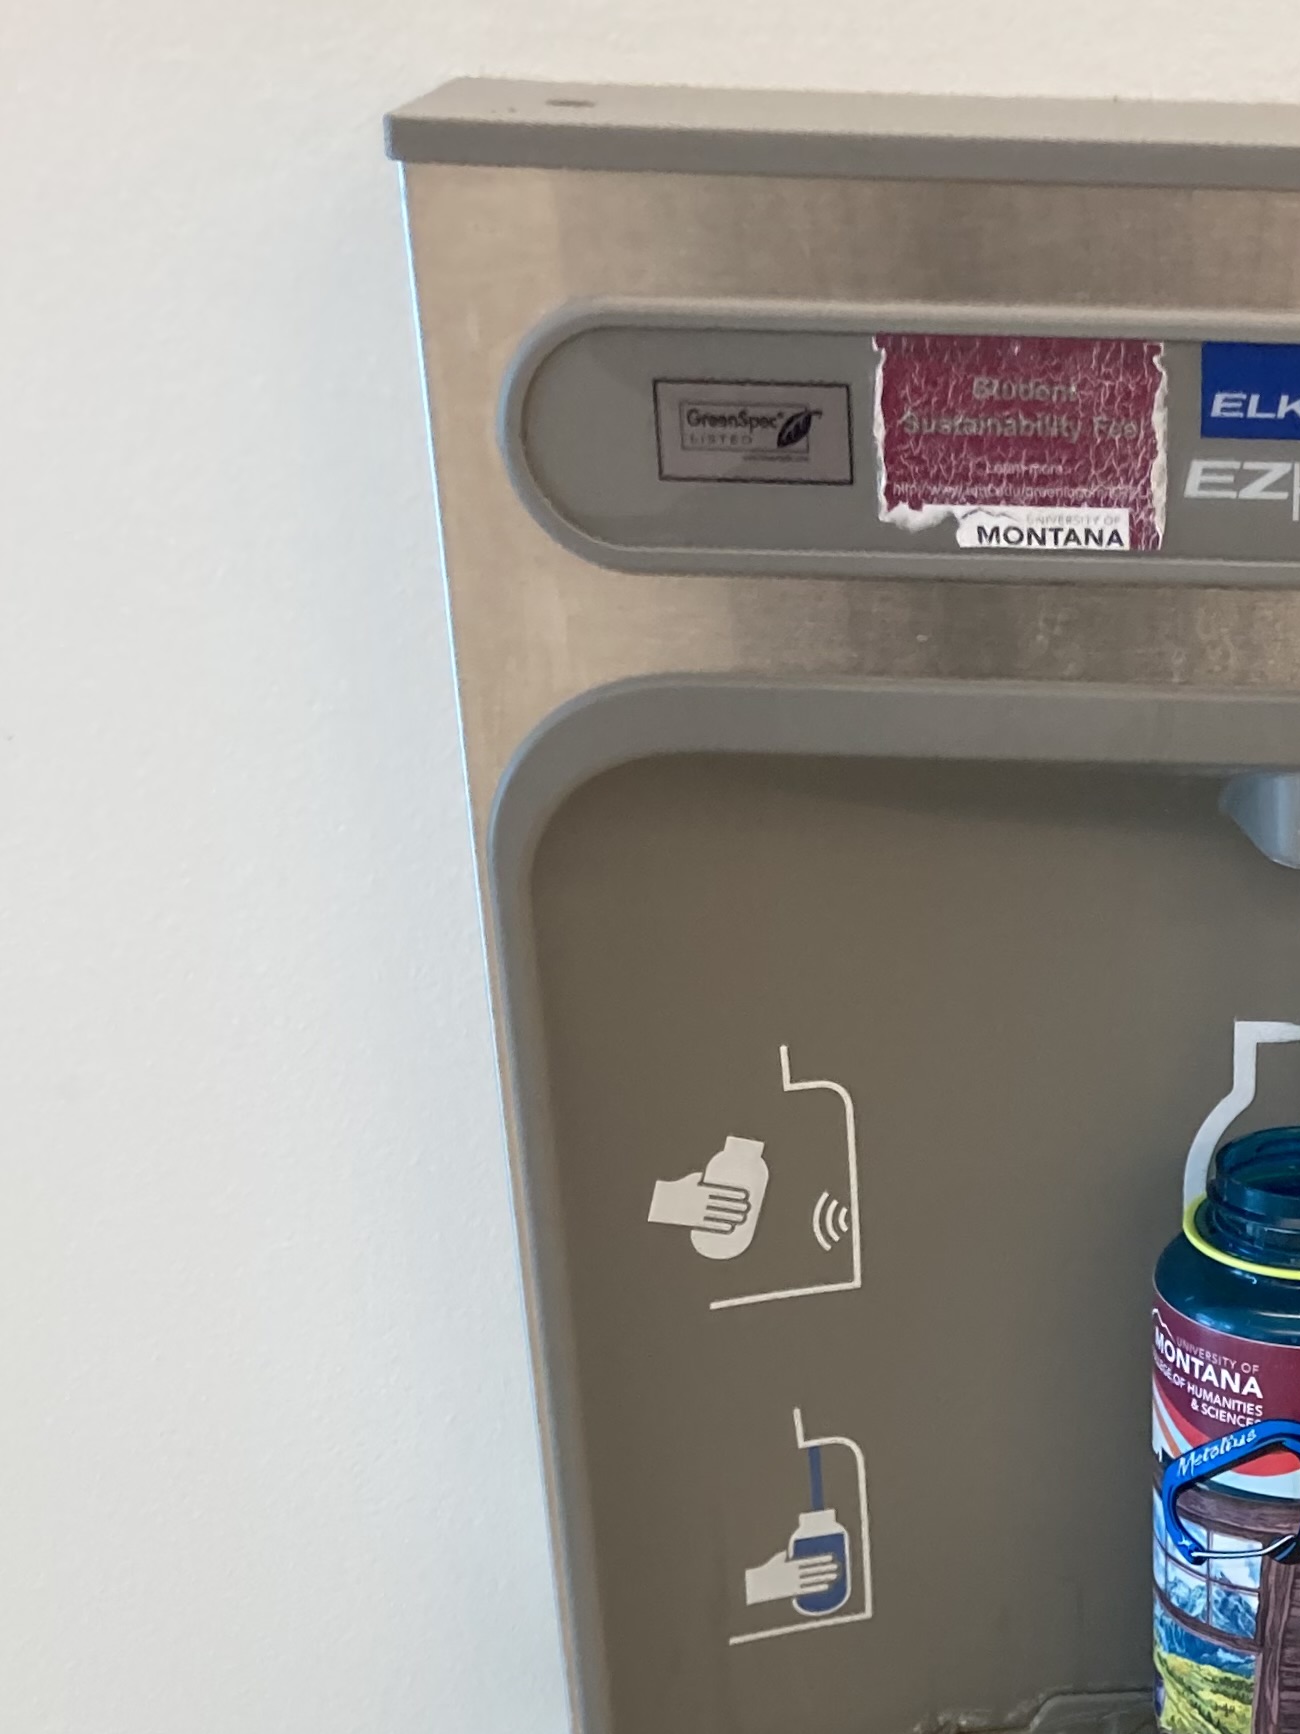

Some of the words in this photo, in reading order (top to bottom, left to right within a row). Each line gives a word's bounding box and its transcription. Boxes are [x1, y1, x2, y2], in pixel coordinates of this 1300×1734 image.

[901, 409, 1082, 444] Sustainability
[976, 525, 1125, 547] MONTANA
[1025, 515, 1101, 526] UNIVERSITY
[1103, 516, 1122, 526] OF
[1154, 1325, 1264, 1399] MONTANA
[1175, 1336, 1238, 1370] UNIVERSITY
[1240, 1362, 1260, 1374] OF
[1172, 1372, 1187, 1388] OF
[1186, 1381, 1264, 1417] HUMANITIES
[1190, 1398, 1200, 1412] &
[1177, 1429, 1257, 1477] Metolius
